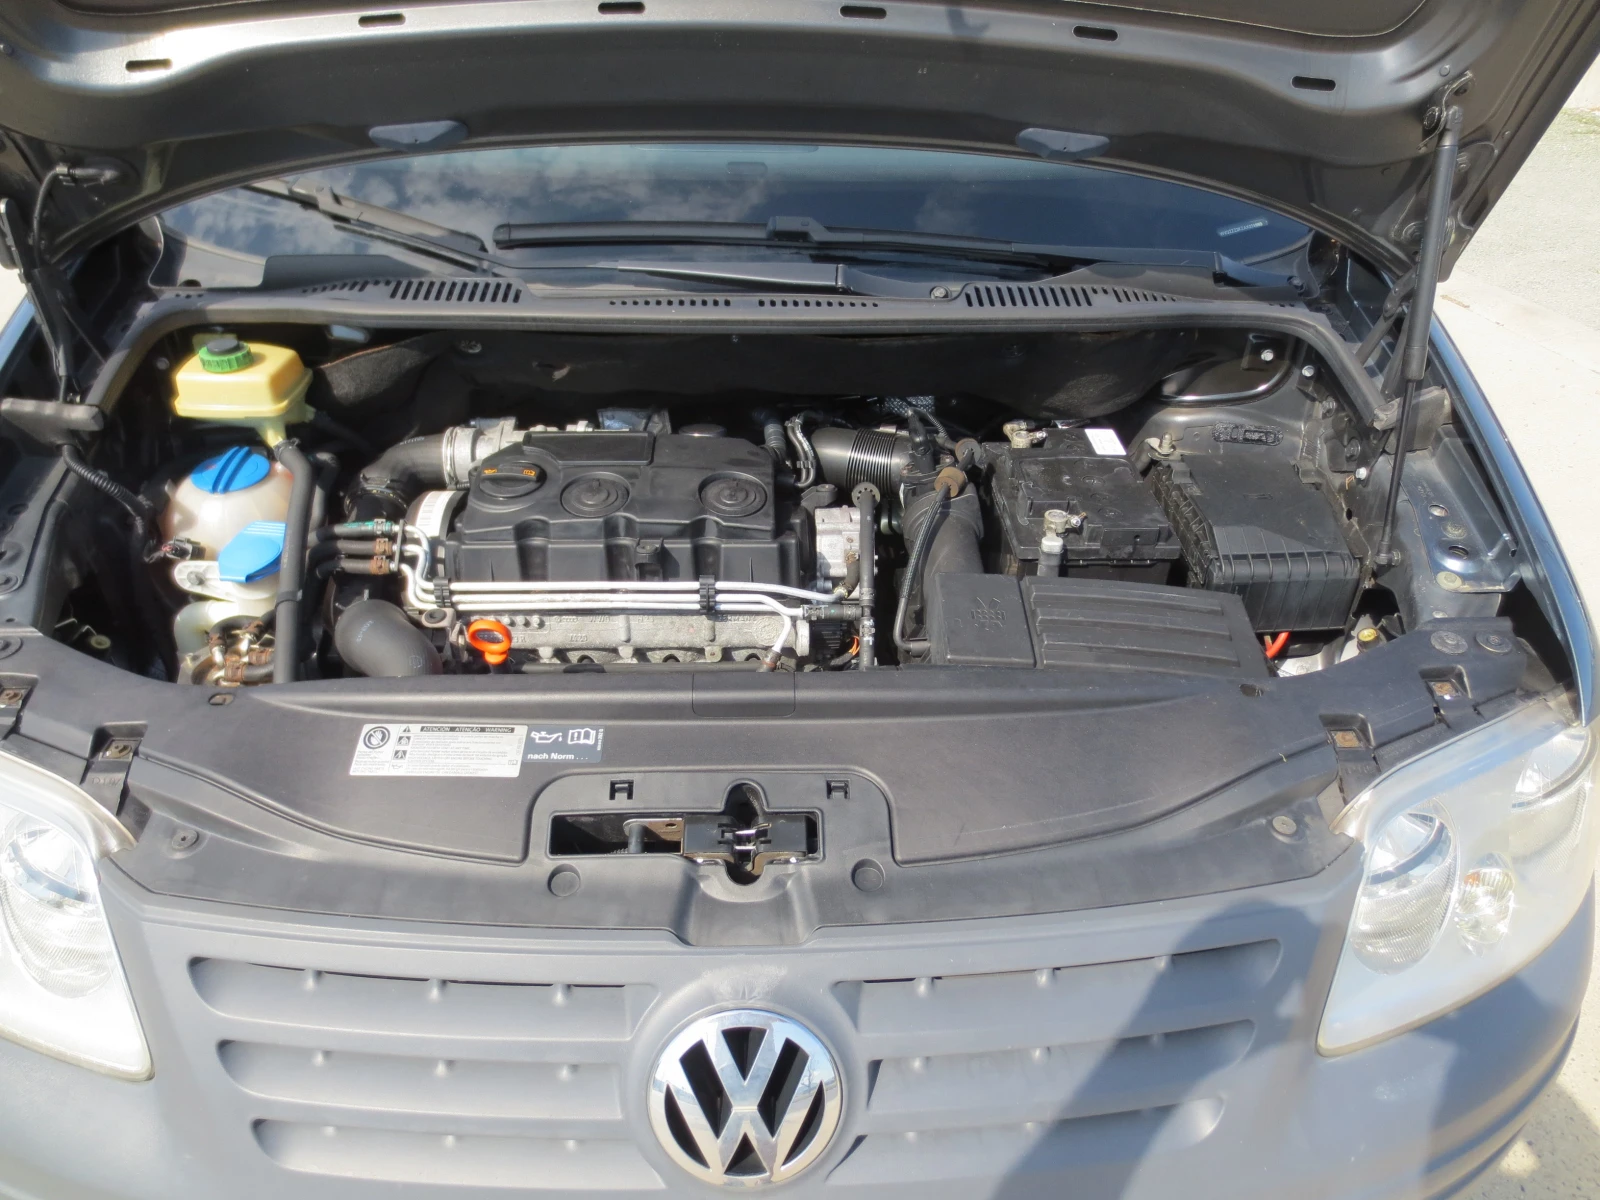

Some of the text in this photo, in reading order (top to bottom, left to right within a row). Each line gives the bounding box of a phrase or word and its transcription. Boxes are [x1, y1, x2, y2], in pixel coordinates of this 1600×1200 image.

[527, 752, 549, 760] nach
[550, 752, 575, 760] Norm
[655, 1018, 834, 1180] VW
